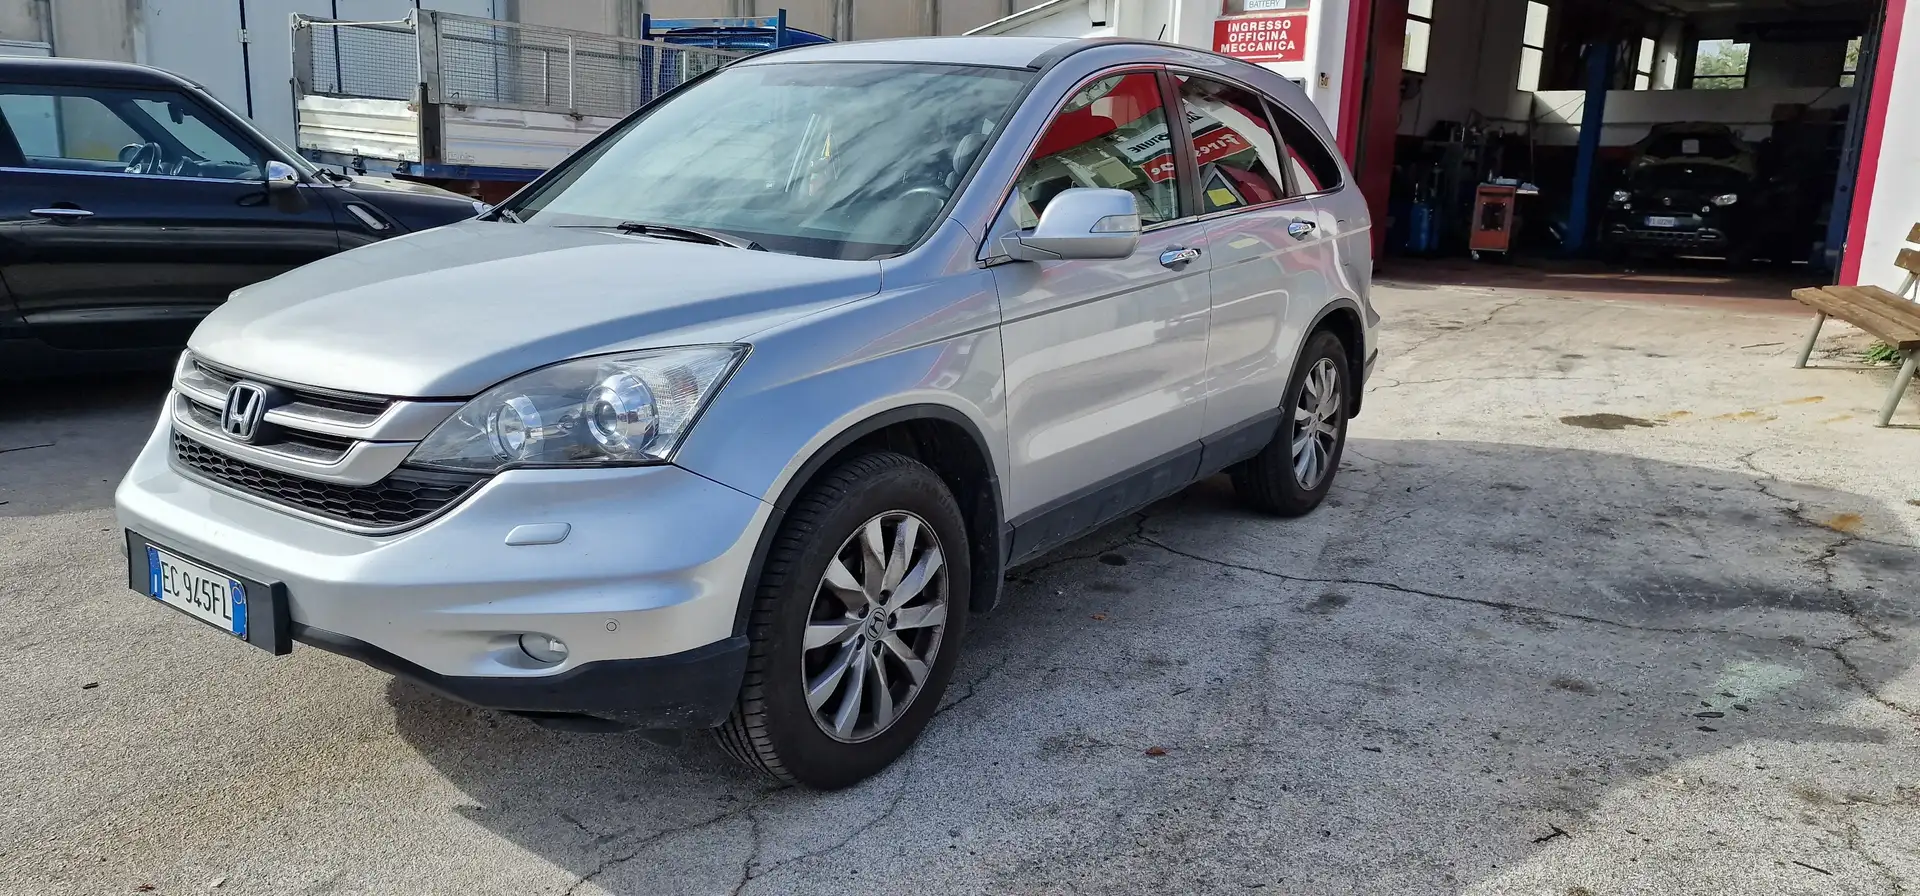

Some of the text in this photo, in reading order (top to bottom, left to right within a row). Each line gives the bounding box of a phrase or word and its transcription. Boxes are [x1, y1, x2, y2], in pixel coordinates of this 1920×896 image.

[1249, 0, 1280, 8] BATTERY
[1228, 20, 1292, 33] INGRESSO
[1229, 30, 1288, 43] OFFICINA
[1220, 40, 1296, 54] MECCANICA
[160, 561, 232, 621] EC 945FL
